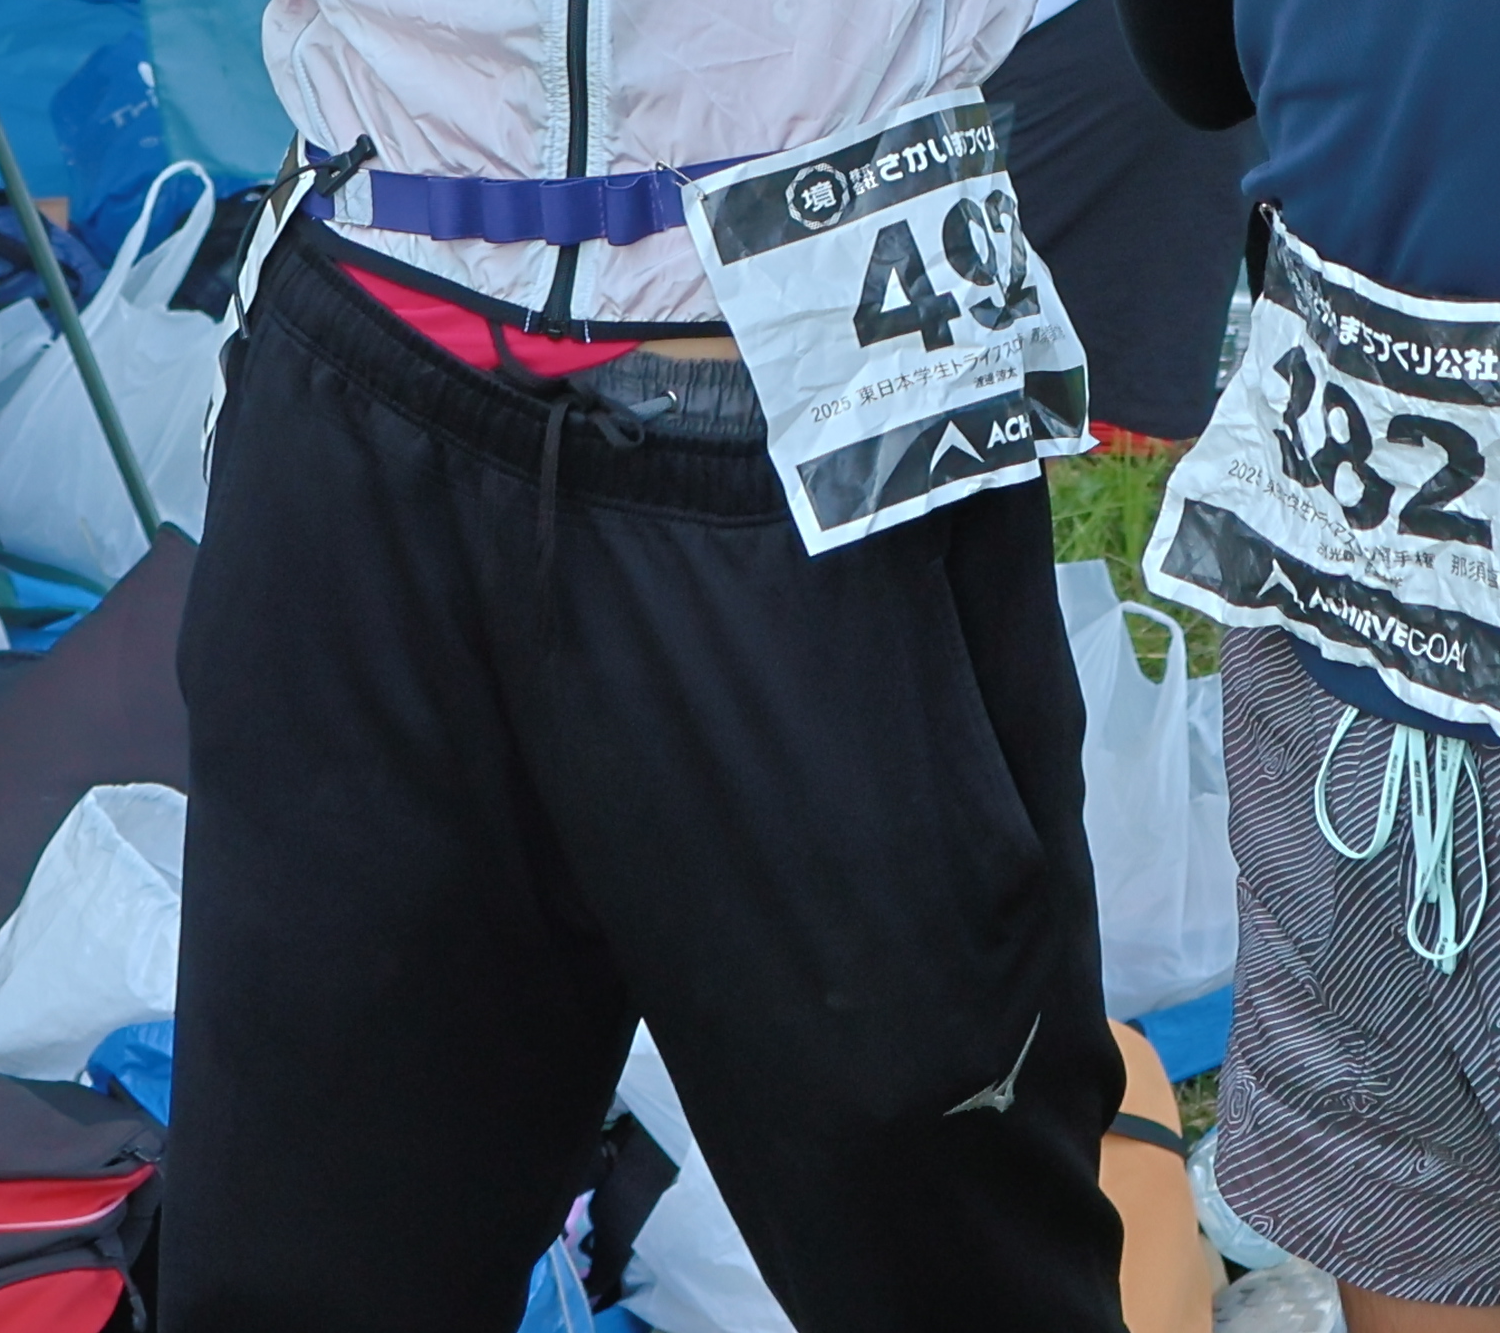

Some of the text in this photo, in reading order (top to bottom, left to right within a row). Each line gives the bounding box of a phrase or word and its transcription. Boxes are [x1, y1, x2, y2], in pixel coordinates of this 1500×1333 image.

[800, 179, 838, 213] 境
[853, 189, 1042, 352] 492
[810, 396, 852, 423] 2025
